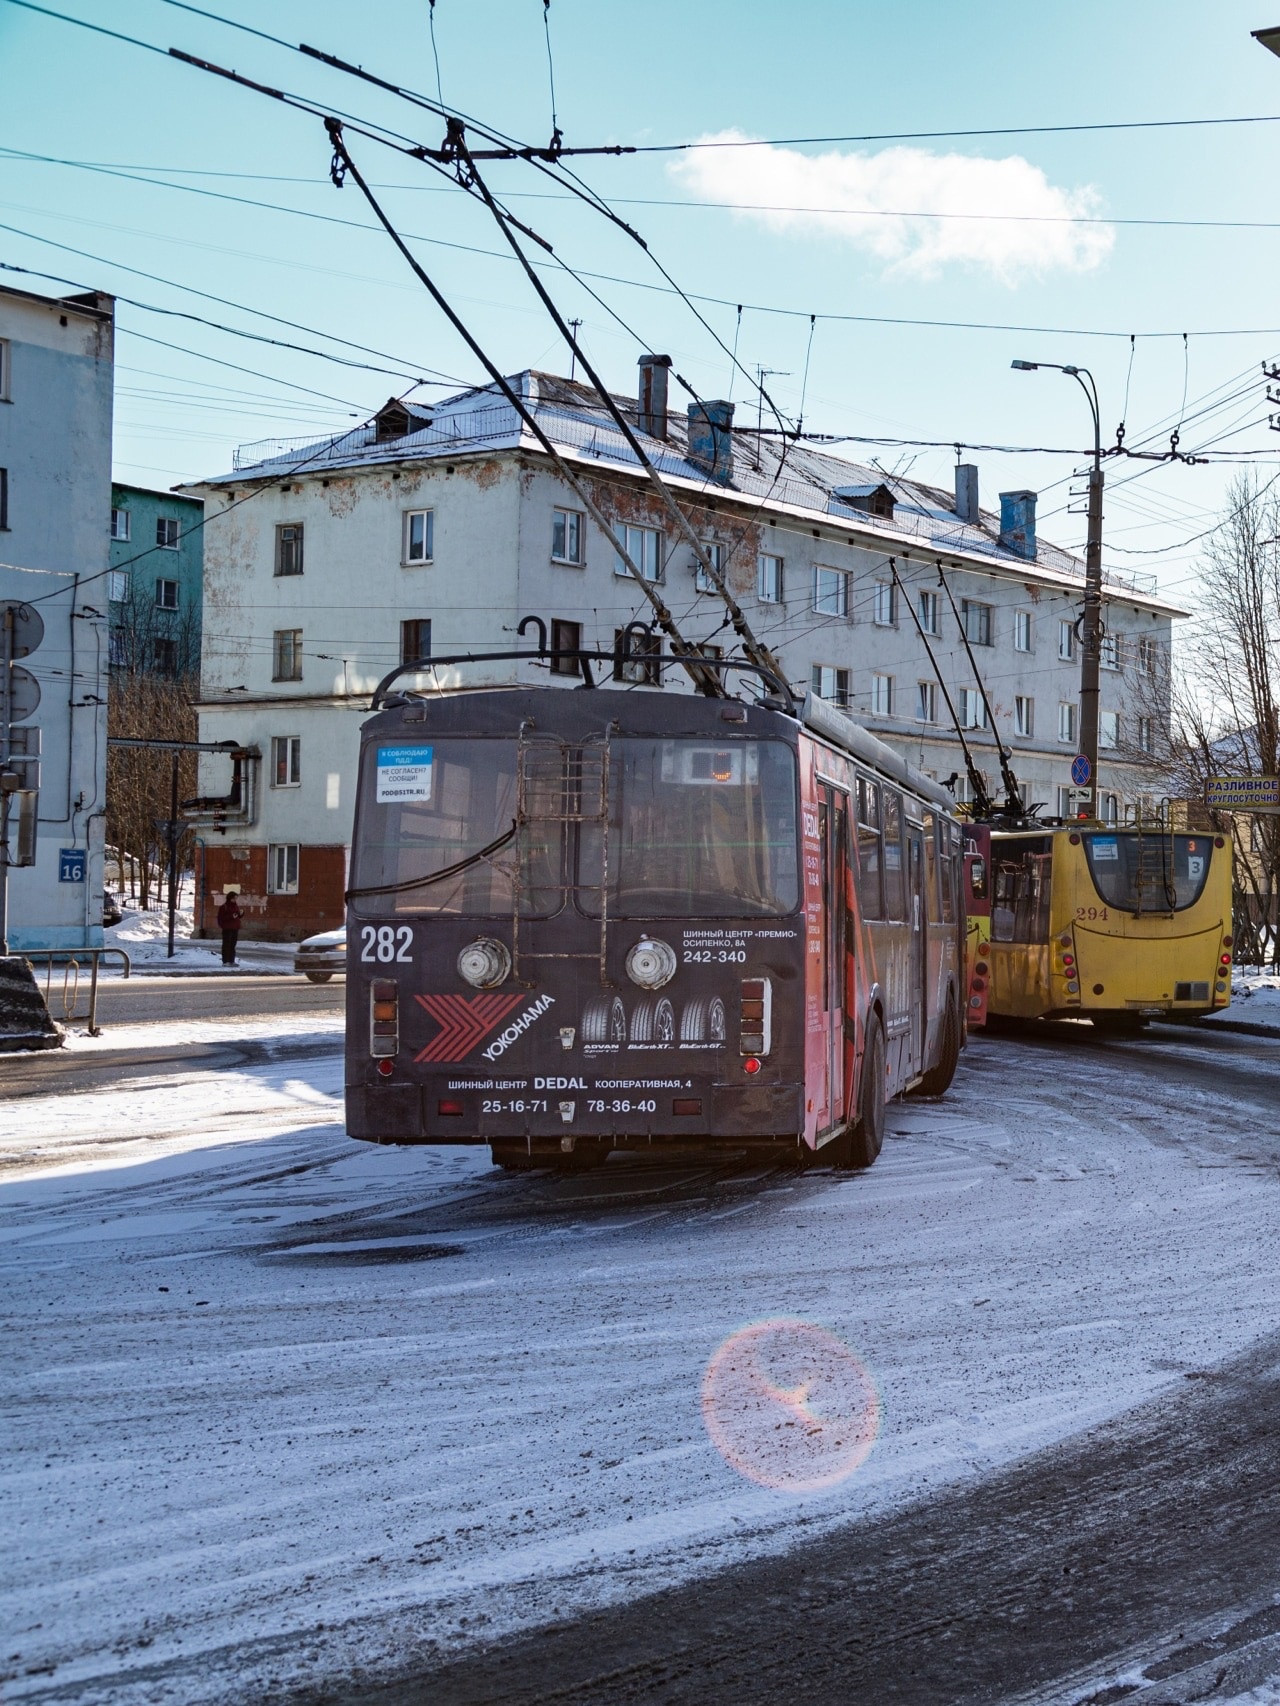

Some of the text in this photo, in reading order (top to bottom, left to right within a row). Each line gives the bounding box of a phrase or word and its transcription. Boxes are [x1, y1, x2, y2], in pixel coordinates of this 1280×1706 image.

[1208, 781, 1278, 791] РАЗЛИВНОЕ
[1207, 793, 1278, 803] КРУГЛОСУТОЧНО
[1188, 841, 1196, 851] 3
[63, 864, 81, 881] 16
[1191, 861, 1201, 874] 3
[1076, 907, 1108, 920] 294
[683, 929, 724, 938] ШИННЫЙ
[725, 930, 753, 939] ЦЕНТР
[361, 925, 414, 962] 282
[683, 939, 746, 947] ОСИПЕНКО, 8А
[683, 950, 746, 963] 242-340
[481, 994, 556, 1062] YOKOHAMA
[448, 1077, 692, 1090] ШИННЫЙ ЦЕНТР DEDAL КООПЕРАТИВНАЯ, 4
[482, 1099, 656, 1112] 25-16-71 78-36-40
